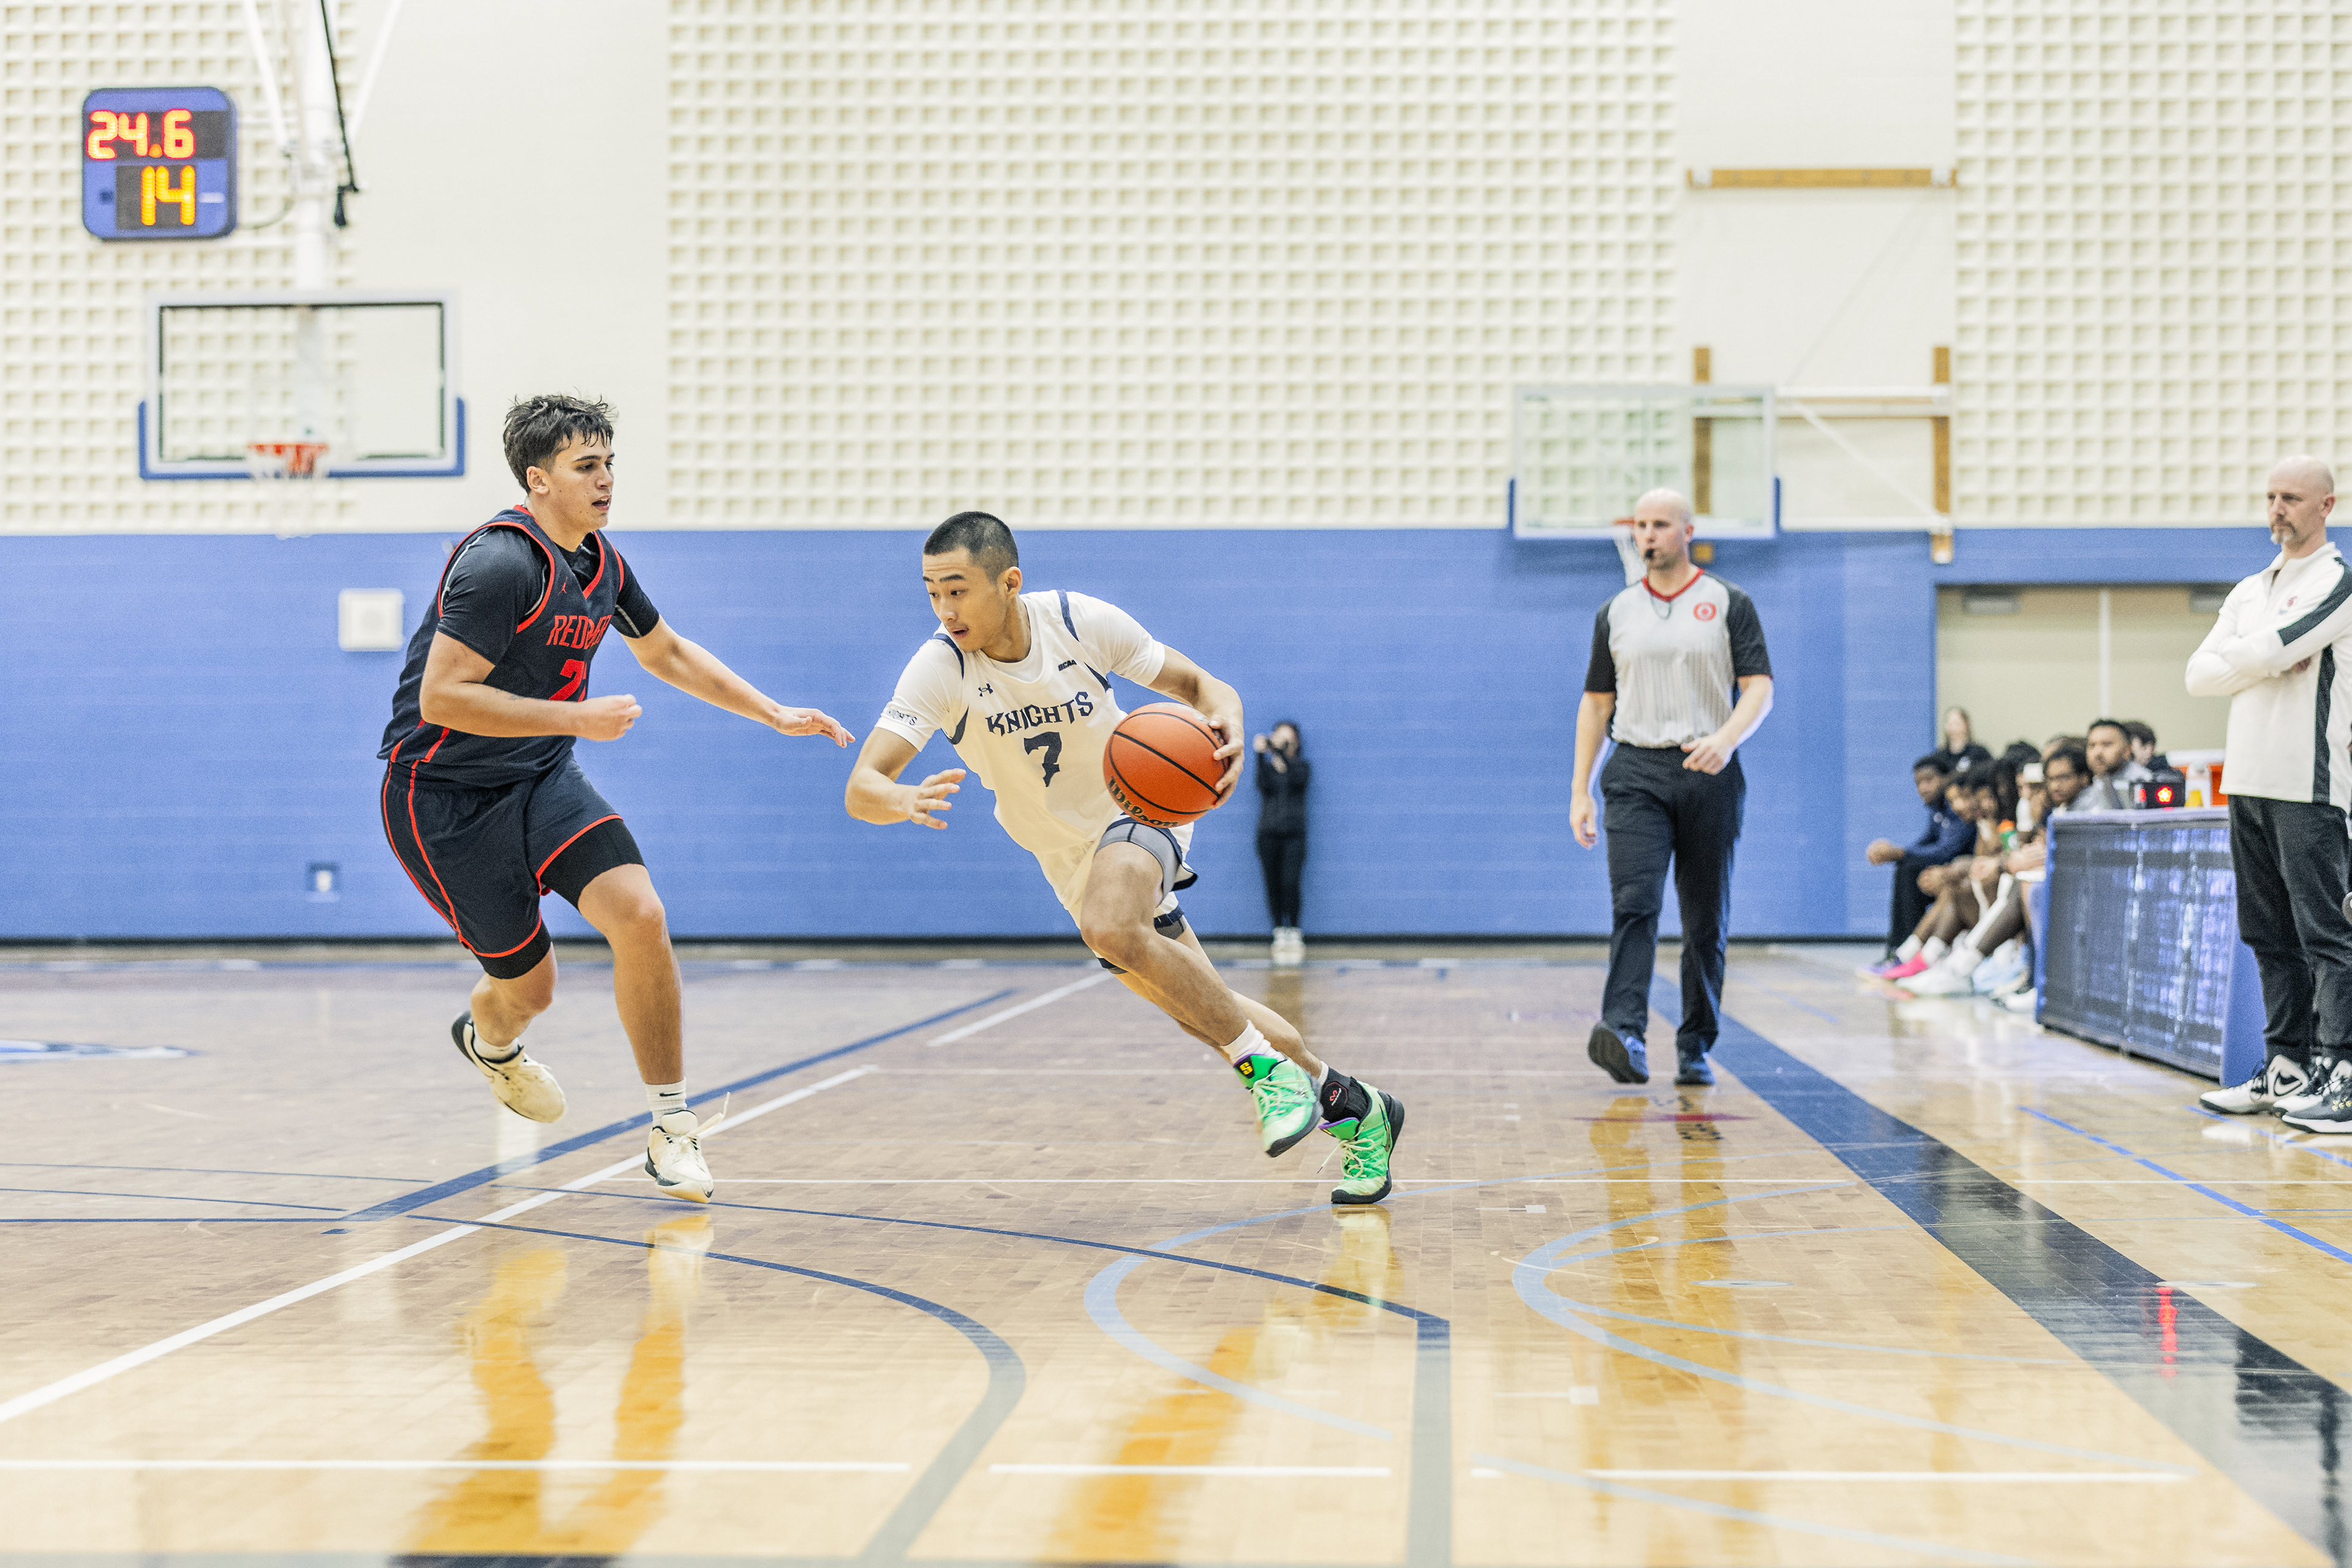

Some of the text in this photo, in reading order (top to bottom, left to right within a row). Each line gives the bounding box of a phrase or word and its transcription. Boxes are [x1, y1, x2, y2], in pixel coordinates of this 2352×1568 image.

[86, 109, 195, 160] 24.6
[141, 165, 195, 225] 14
[1058, 660, 1077, 671] OCAA
[985, 692, 1093, 737] KNIGHTS
[1023, 731, 1062, 788] 7
[1106, 775, 1179, 827] Wilson
